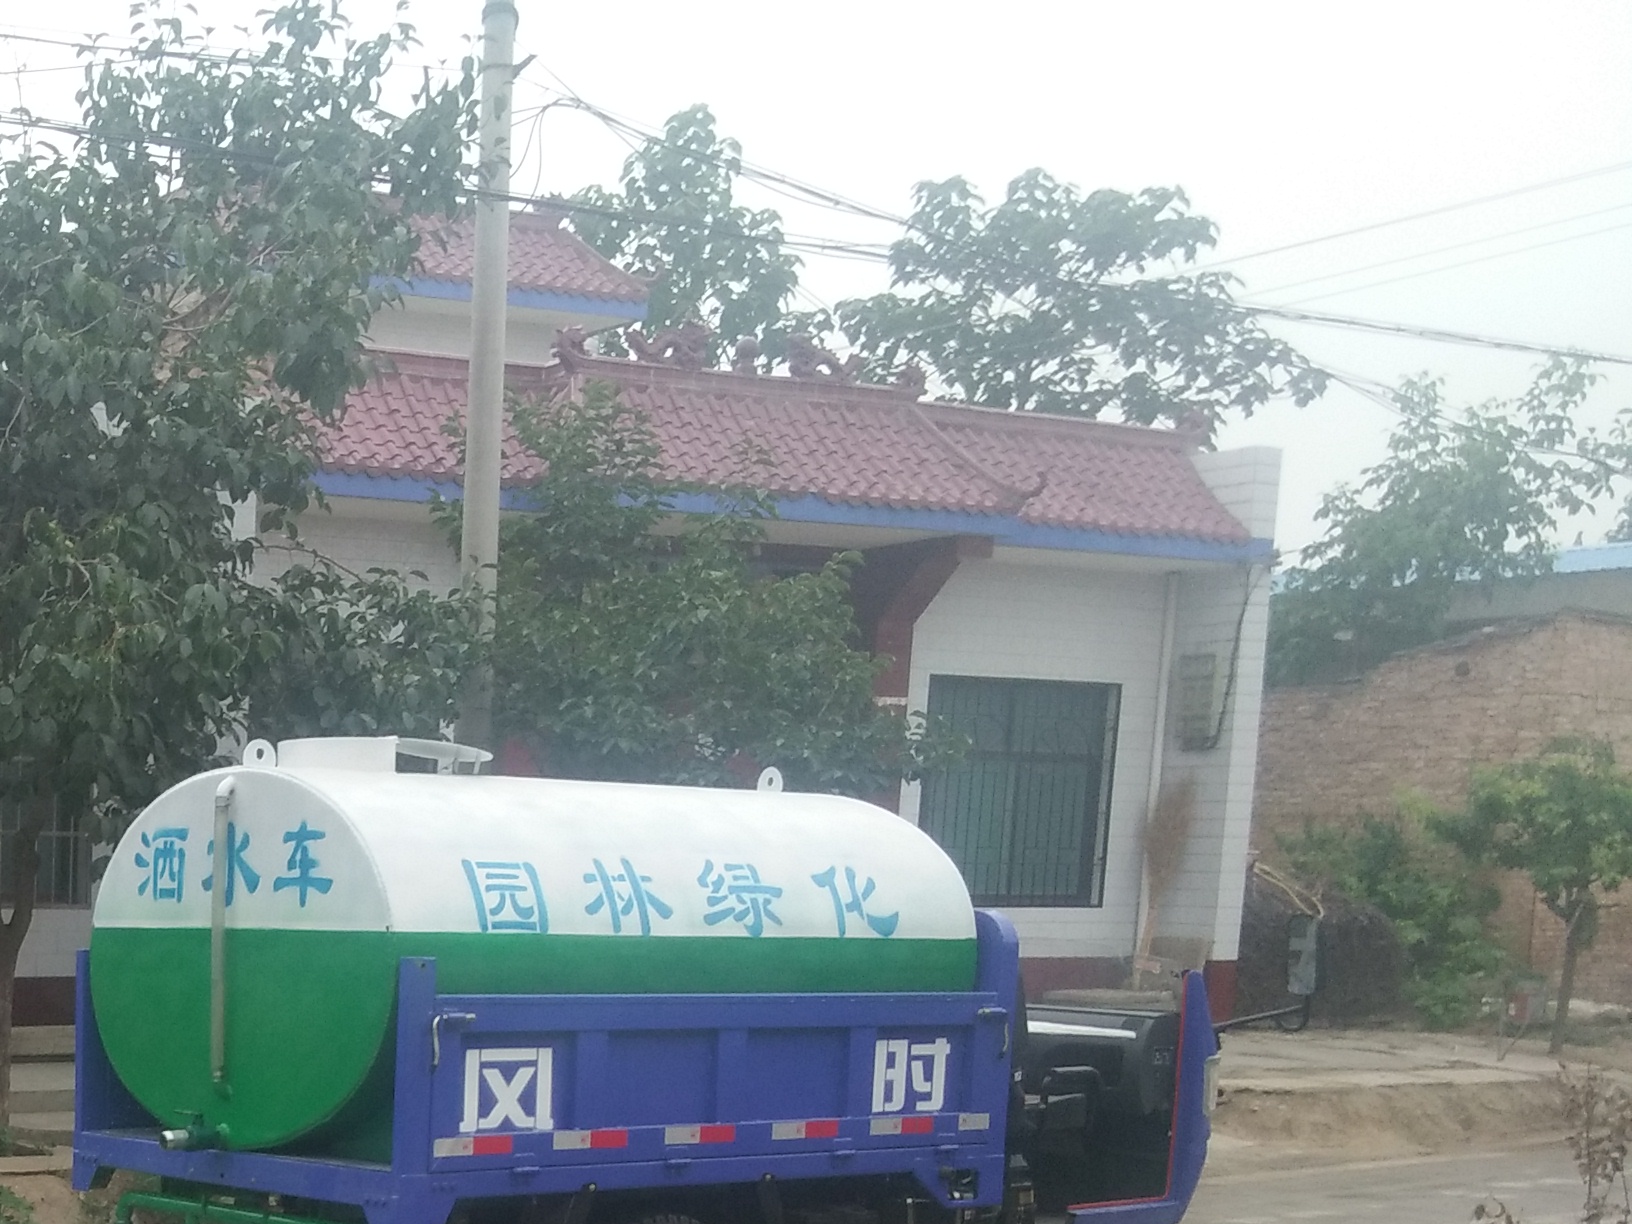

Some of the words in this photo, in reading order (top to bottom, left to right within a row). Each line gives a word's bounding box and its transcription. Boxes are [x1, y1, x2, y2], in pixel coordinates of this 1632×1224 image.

[134, 819, 334, 908] 洒水车
[461, 856, 900, 938] 园林绿化
